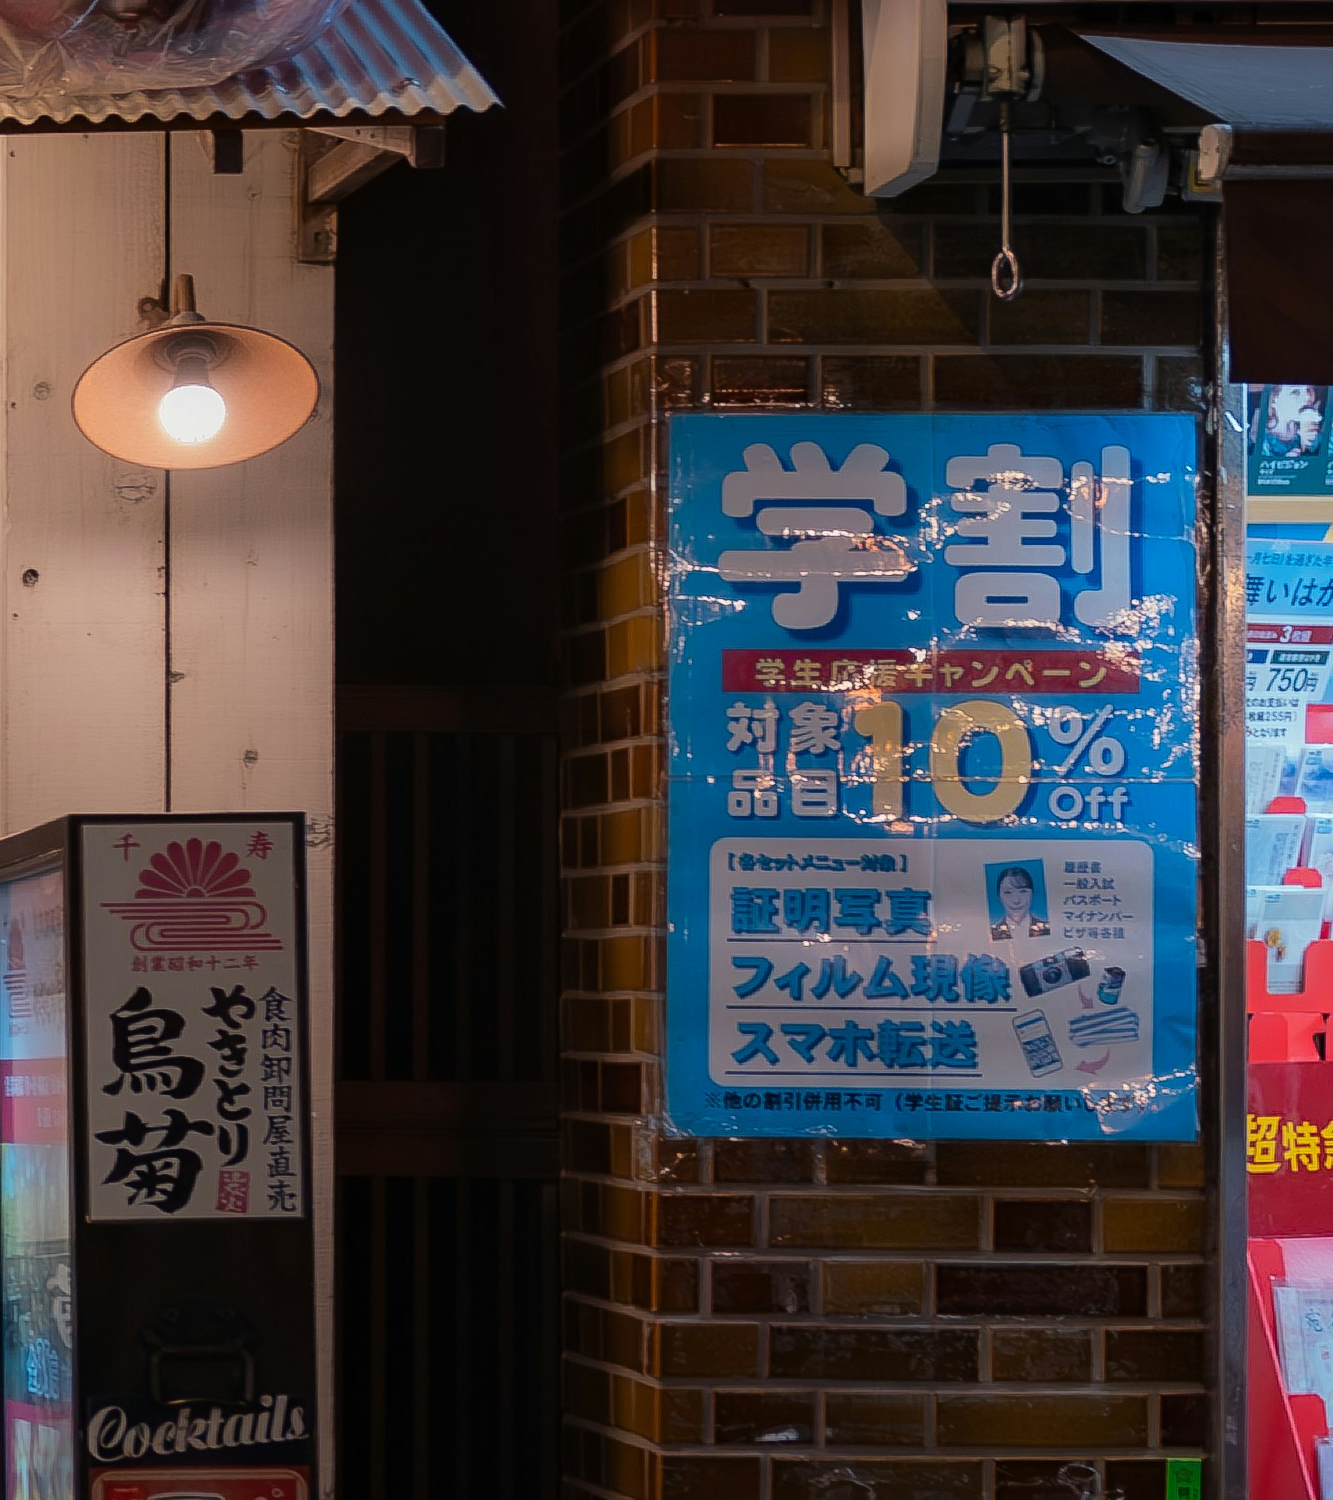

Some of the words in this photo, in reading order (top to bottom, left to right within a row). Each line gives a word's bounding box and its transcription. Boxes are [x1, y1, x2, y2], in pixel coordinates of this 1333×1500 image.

[719, 440, 1133, 632] 学割
[754, 657, 1109, 690] 学生応援キャンペーン
[725, 701, 842, 755] 対象
[726, 768, 840, 818] 品目
[1048, 786, 1129, 821] Off
[112, 833, 141, 862] 千
[245, 830, 275, 860] 寿
[730, 886, 934, 936] 証明写真
[730, 953, 1012, 1004] フィルム現像
[730, 1019, 979, 1071] スマホ転送
[93, 984, 216, 1215] 鳥菊
[201, 983, 257, 1169] やきとり
[258, 985, 298, 1212] 食肉卸問屋直売
[86, 1393, 311, 1463] Cocktails
